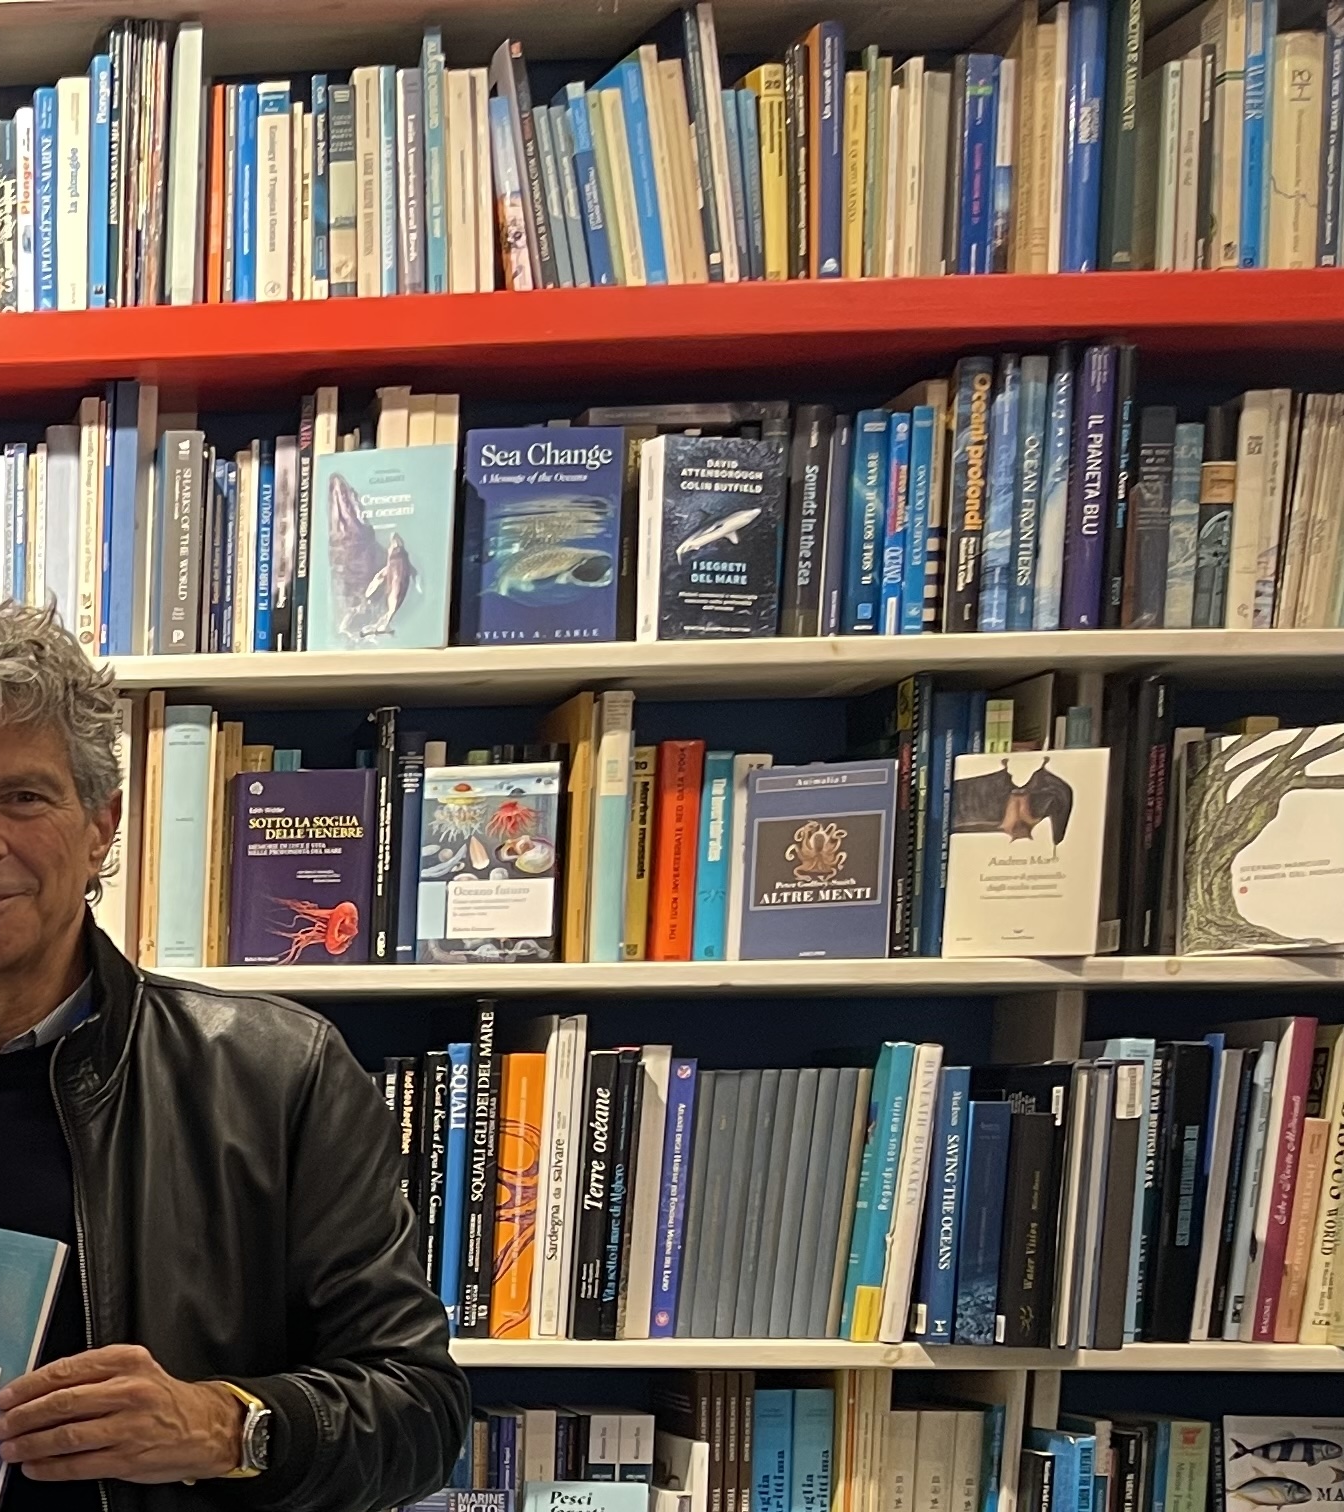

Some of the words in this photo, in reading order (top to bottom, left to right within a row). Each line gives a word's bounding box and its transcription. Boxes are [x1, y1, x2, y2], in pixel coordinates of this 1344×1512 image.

[21, 156, 31, 215] Plonger
[972, 372, 994, 441] Oceani
[1087, 414, 1104, 429] IL
[481, 444, 522, 467] Sea
[527, 442, 613, 471] Change
[707, 459, 738, 468] DAVID
[1022, 435, 1040, 492] OCEAN
[1083, 433, 1104, 500] PIANETA
[680, 468, 764, 480] ATTENBOROUGH
[680, 481, 712, 491] COLIN
[713, 482, 763, 494] BUTFIELD
[802, 465, 819, 509] Sounds
[964, 445, 986, 531] profondi
[181, 468, 192, 513] SHARKS
[261, 484, 271, 524] SQUALI
[360, 493, 412, 506] Crescere
[181, 516, 191, 530] OF
[1081, 503, 1100, 536] BLU
[180, 533, 190, 556] THE
[259, 527, 270, 561] DEGLI
[799, 533, 815, 557] the
[1016, 499, 1036, 586] FRONTIERS
[178, 559, 189, 600] WORLD
[258, 563, 269, 598] LIBRO
[691, 573, 713, 583] DEL
[714, 574, 748, 585] MARE
[699, 560, 747, 572] SEGRETI
[797, 560, 812, 586] sea
[258, 601, 268, 610] IL
[248, 817, 293, 829] SOTTO
[294, 817, 310, 828] LA
[313, 816, 359, 827] SOGLIA
[265, 828, 306, 841] DELLE
[306, 827, 364, 838] TENEBRE
[454, 886, 493, 896] Oceano
[495, 885, 530, 895] futuro
[760, 890, 814, 904] ALTRE
[818, 887, 871, 901] MENTI
[478, 1012, 494, 1056] MARE
[477, 1060, 491, 1089] DEL
[450, 1063, 468, 1130] SQUALI
[476, 1092, 490, 1117] DEI
[474, 1121, 488, 1145] GLI
[593, 1087, 611, 1153] océane
[553, 1138, 567, 1182] salvare
[943, 1134, 960, 1183] SAVING
[471, 1148, 486, 1202] SQUALI
[584, 1160, 605, 1211] Terre
[554, 1187, 563, 1200] da
[942, 1185, 957, 1214] THE
[547, 1205, 564, 1261] Sardegna
[938, 1216, 953, 1270] OCEANS
[458, 1492, 505, 1505] MARINE
[550, 1490, 593, 1506] Pesci
